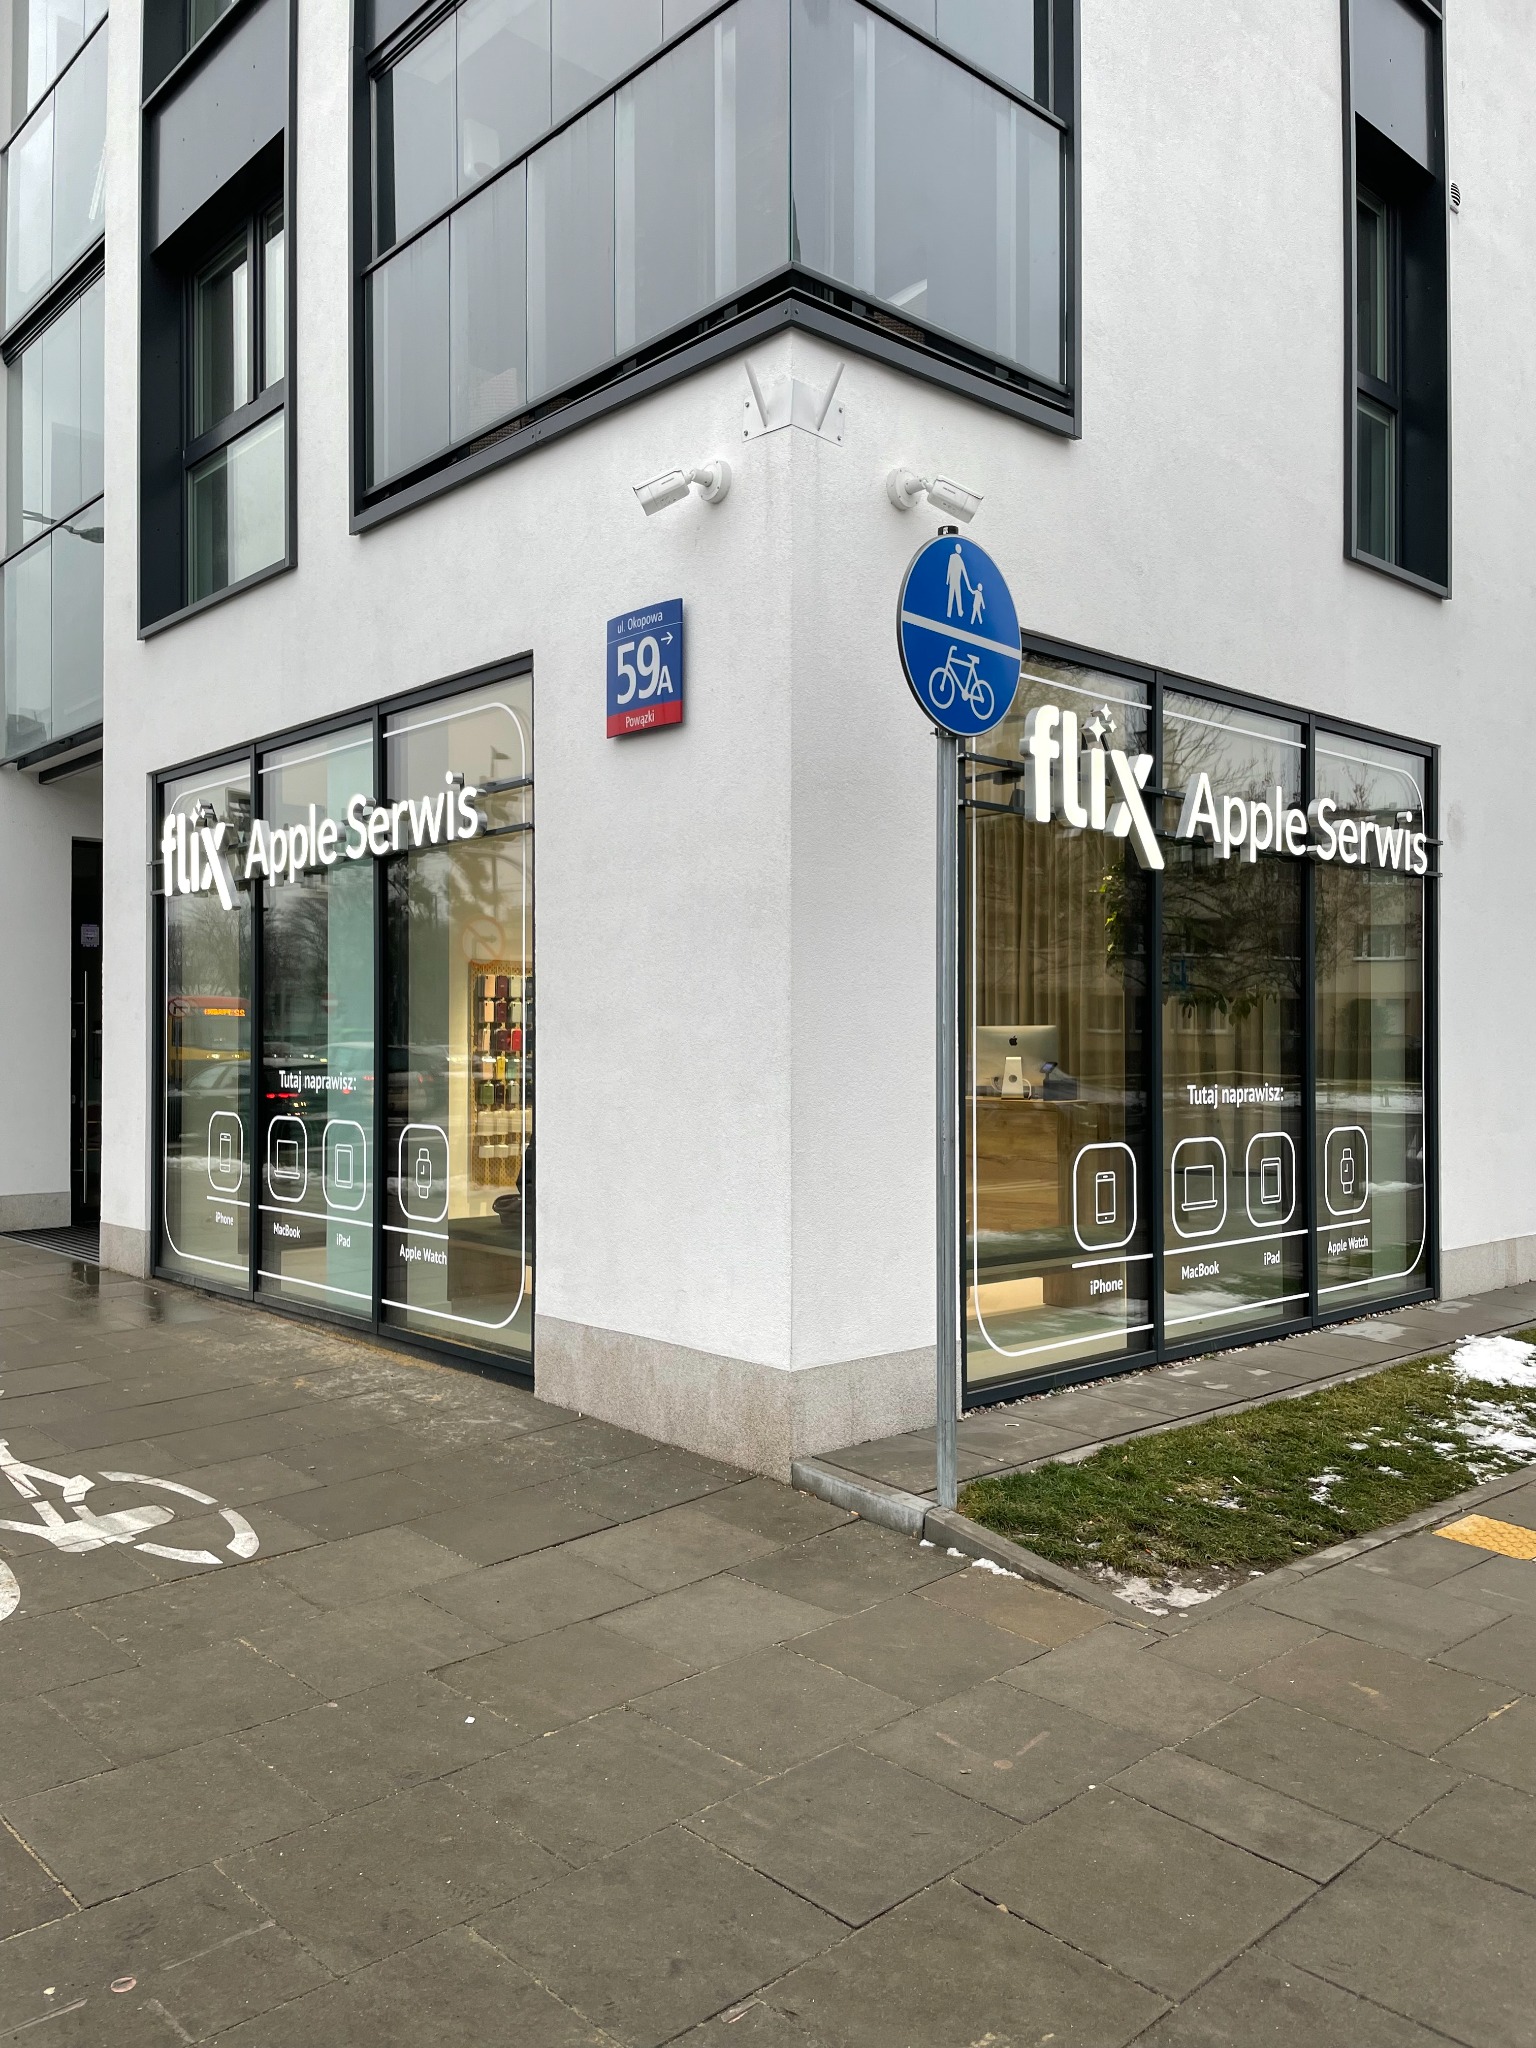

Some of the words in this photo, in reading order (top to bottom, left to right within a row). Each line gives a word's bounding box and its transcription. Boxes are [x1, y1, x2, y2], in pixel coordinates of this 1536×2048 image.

[617, 619, 626, 634] ul.
[627, 611, 663, 631] Okopowa
[617, 635, 674, 705] 59A
[625, 710, 655, 728] Powązki
[1030, 703, 1165, 870] flix
[1185, 772, 1307, 864] Apple
[1315, 797, 1428, 875] Serwis
[161, 799, 233, 911] flix
[244, 803, 338, 888] Apple
[345, 771, 478, 860] Serwis
[278, 1069, 302, 1093] Tutaj
[304, 1071, 357, 1094] naprawisz:
[1186, 1083, 1218, 1110] Tutaj
[1221, 1081, 1284, 1108] naprawisz:
[215, 1211, 234, 1226] iPhone
[273, 1222, 301, 1239] MacBook
[336, 1232, 351, 1248] iPad
[399, 1243, 422, 1262] Apple
[422, 1247, 448, 1266] Watch
[1327, 1239, 1348, 1256] Apple
[1348, 1235, 1369, 1251] Watch
[1263, 1249, 1281, 1266] iPad
[1181, 1260, 1220, 1281] MacBook
[1089, 1277, 1124, 1296] iPhone
